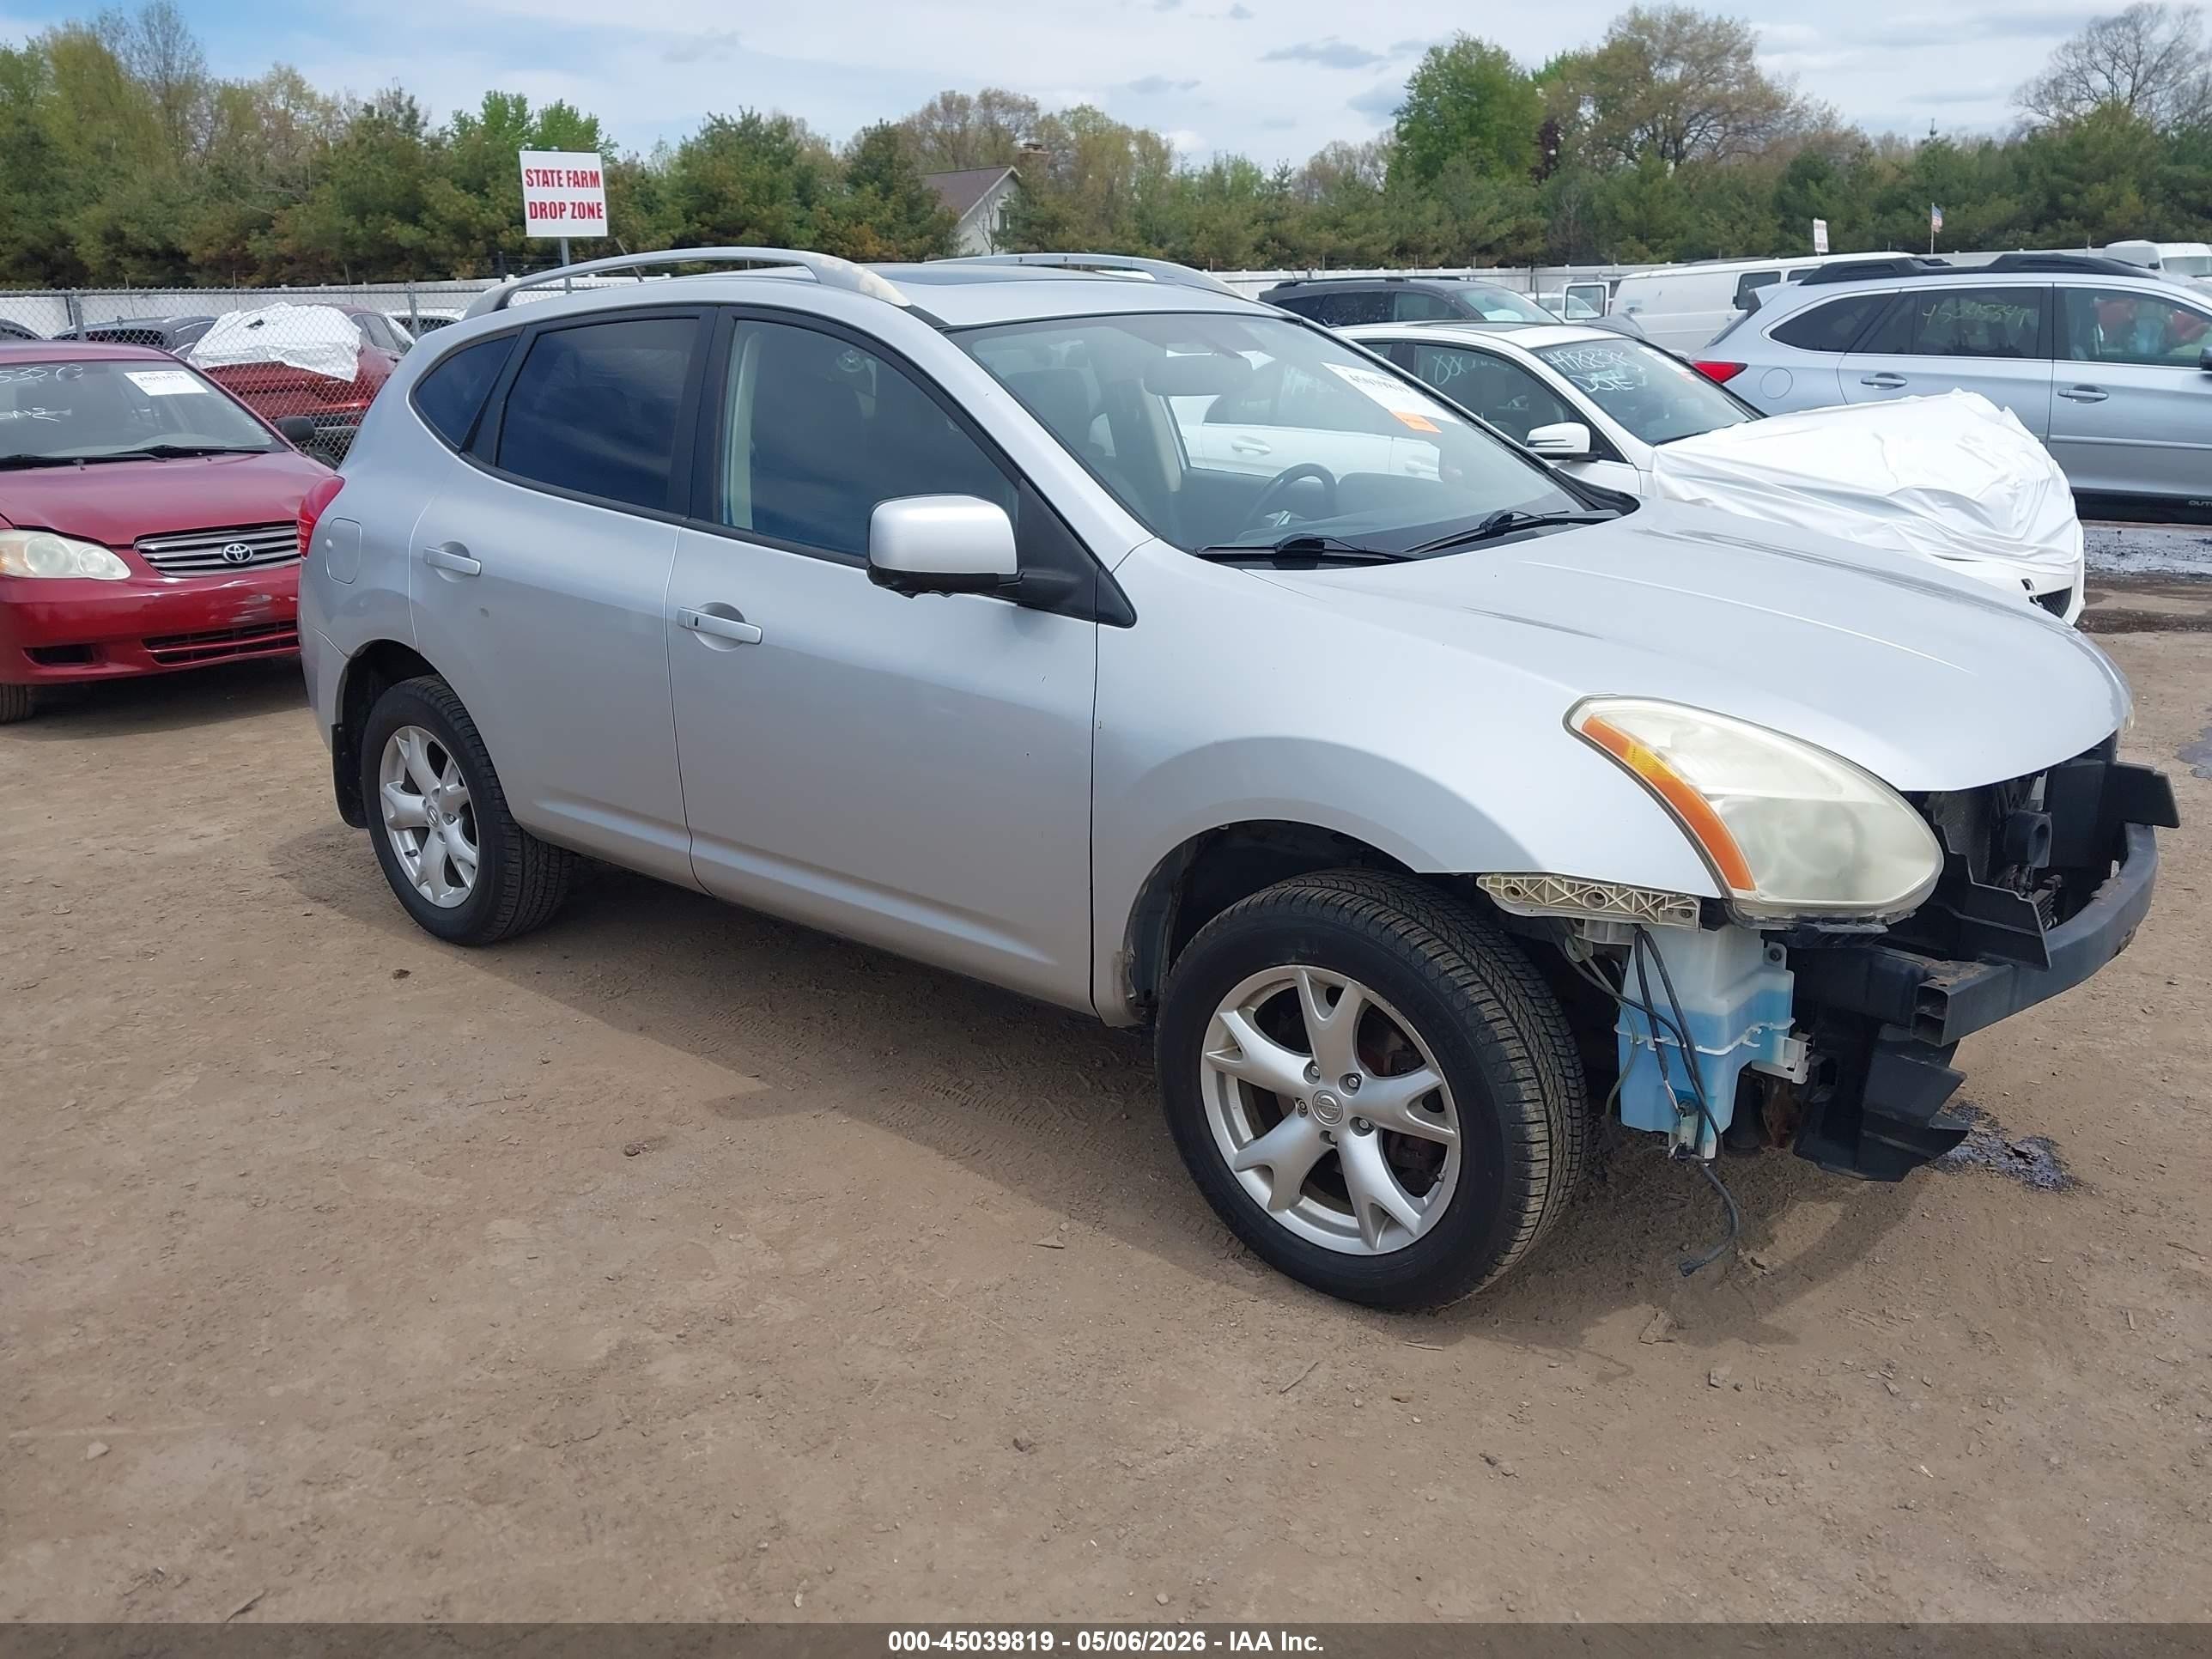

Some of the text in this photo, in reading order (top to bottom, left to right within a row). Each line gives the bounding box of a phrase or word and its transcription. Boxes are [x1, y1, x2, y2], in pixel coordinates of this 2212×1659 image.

[526, 168, 600, 188] STATE FARM
[529, 201, 603, 220] DROP ZONE
